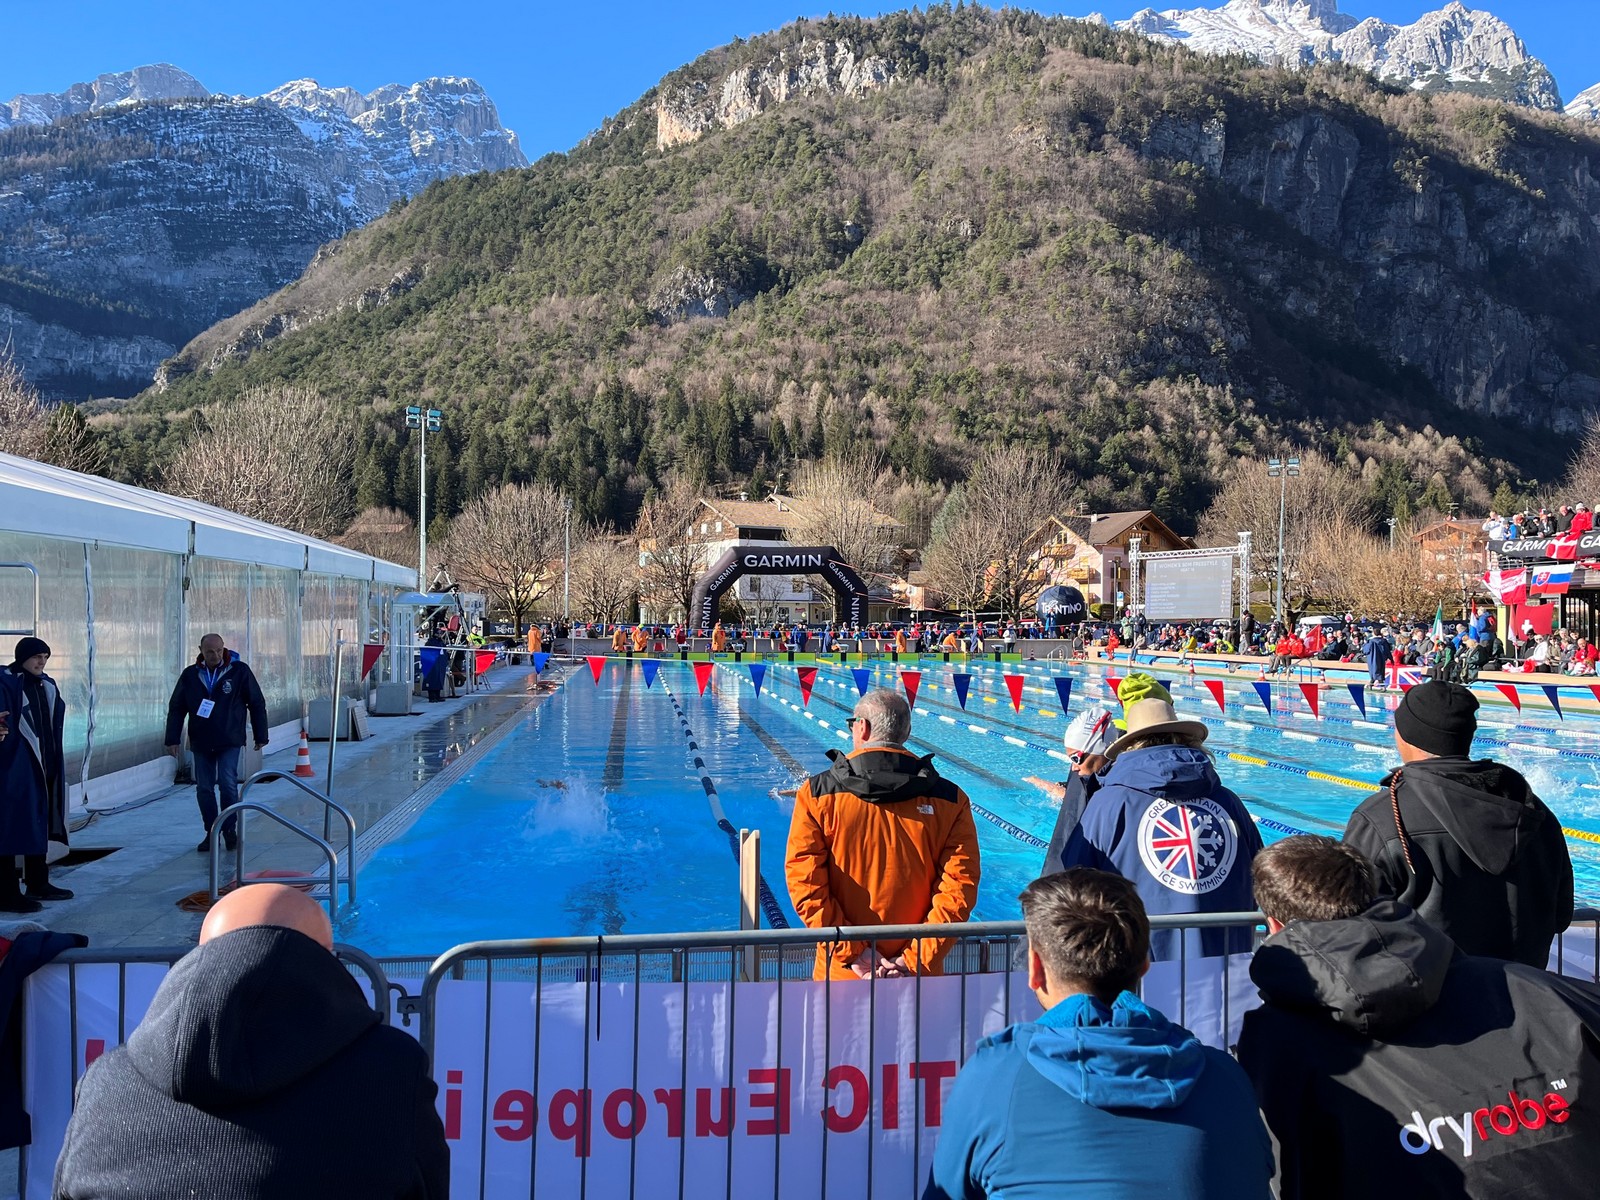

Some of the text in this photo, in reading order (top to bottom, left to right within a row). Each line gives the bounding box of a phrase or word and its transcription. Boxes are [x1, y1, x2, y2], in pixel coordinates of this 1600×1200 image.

[1502, 539, 1552, 552] GARMI
[744, 554, 822, 568] GARMIN
[709, 562, 738, 591] GARMIN
[828, 562, 854, 592] GARMIN
[701, 597, 712, 638] ARMIN
[851, 597, 859, 630] RMIN
[1041, 600, 1082, 615] TRNTINO
[1158, 867, 1227, 891] ICE SWIMMING
[1400, 1090, 1570, 1157] dryrobe
